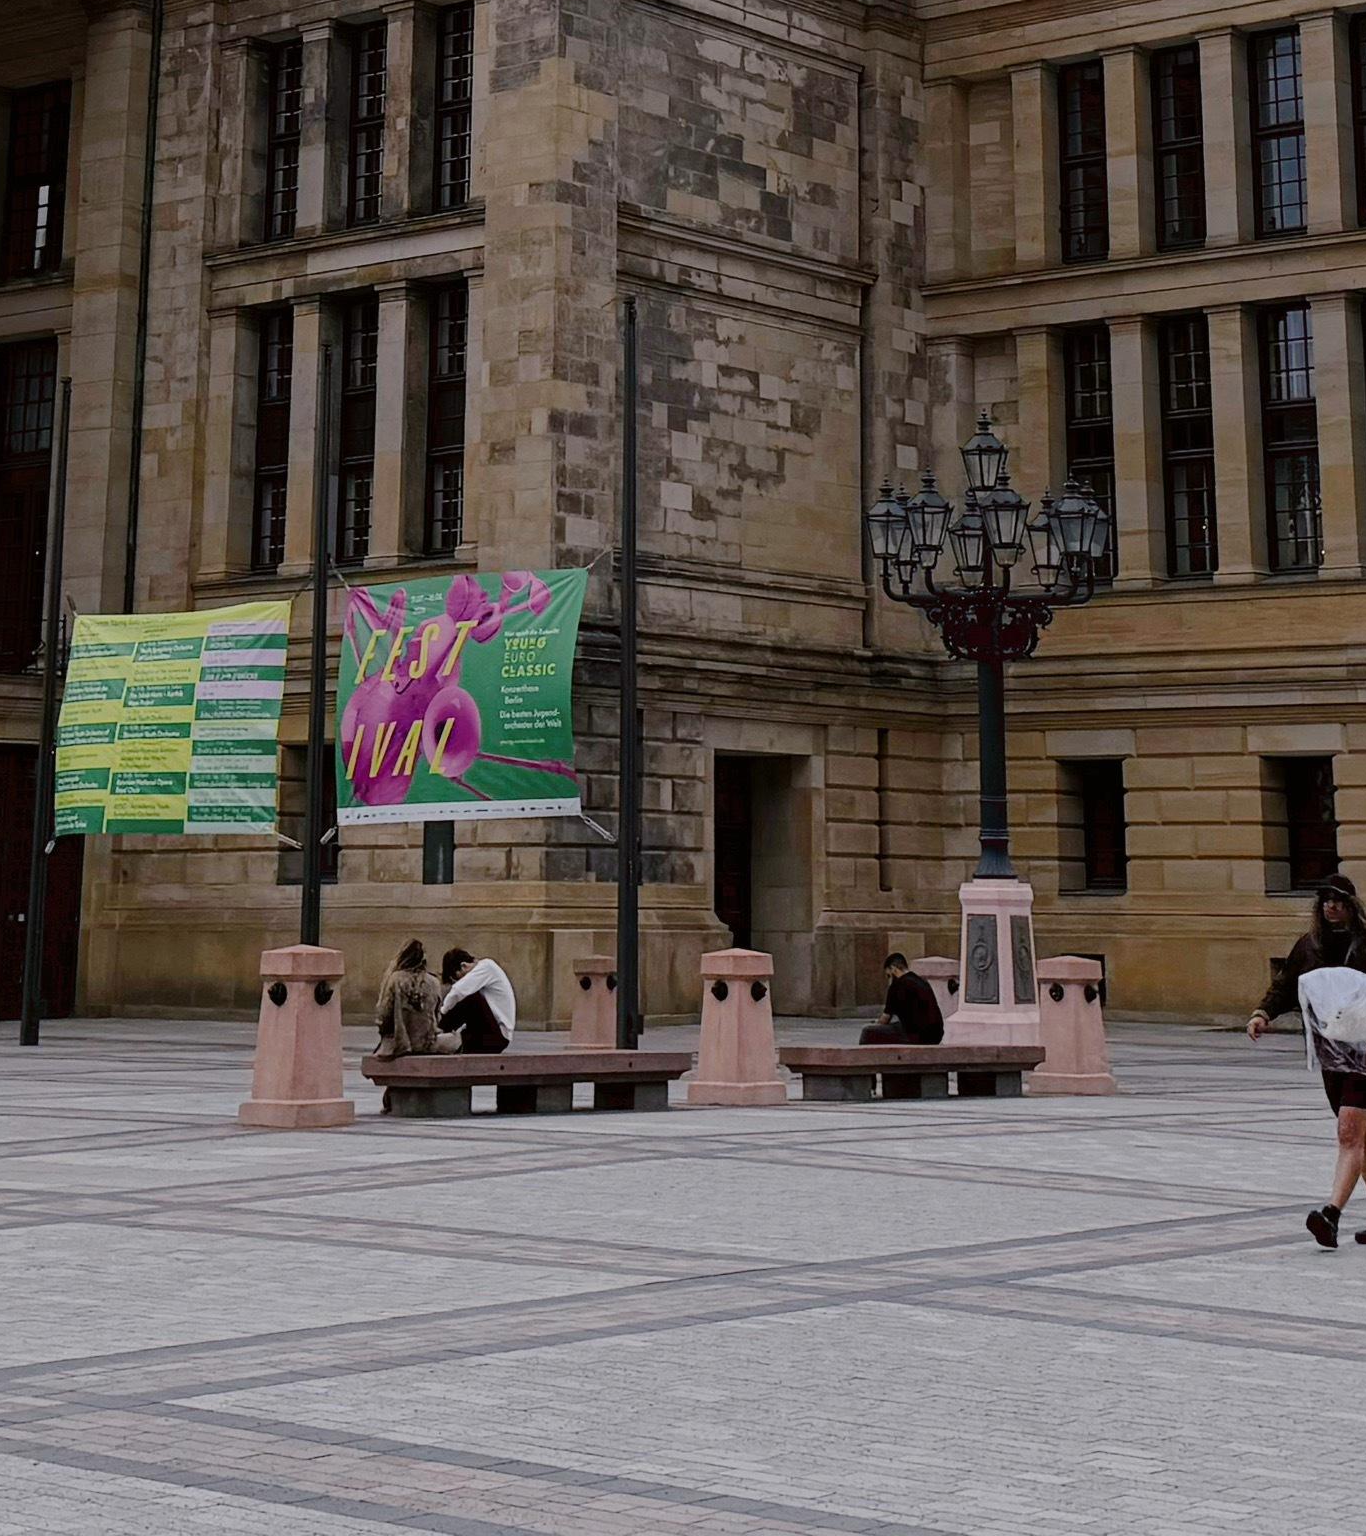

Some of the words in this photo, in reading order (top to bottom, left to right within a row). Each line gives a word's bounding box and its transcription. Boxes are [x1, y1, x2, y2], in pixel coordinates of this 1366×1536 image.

[504, 636, 547, 651] YOUNG
[354, 619, 479, 684] FEST
[503, 651, 535, 663] EURO
[501, 663, 556, 677] CLASSIC
[500, 684, 539, 693] Konzerthaus
[504, 696, 523, 704] Berlin
[499, 710, 509, 718] Die
[511, 710, 532, 718] besten
[546, 719, 562, 727] Welt
[346, 717, 455, 780] IVAL
